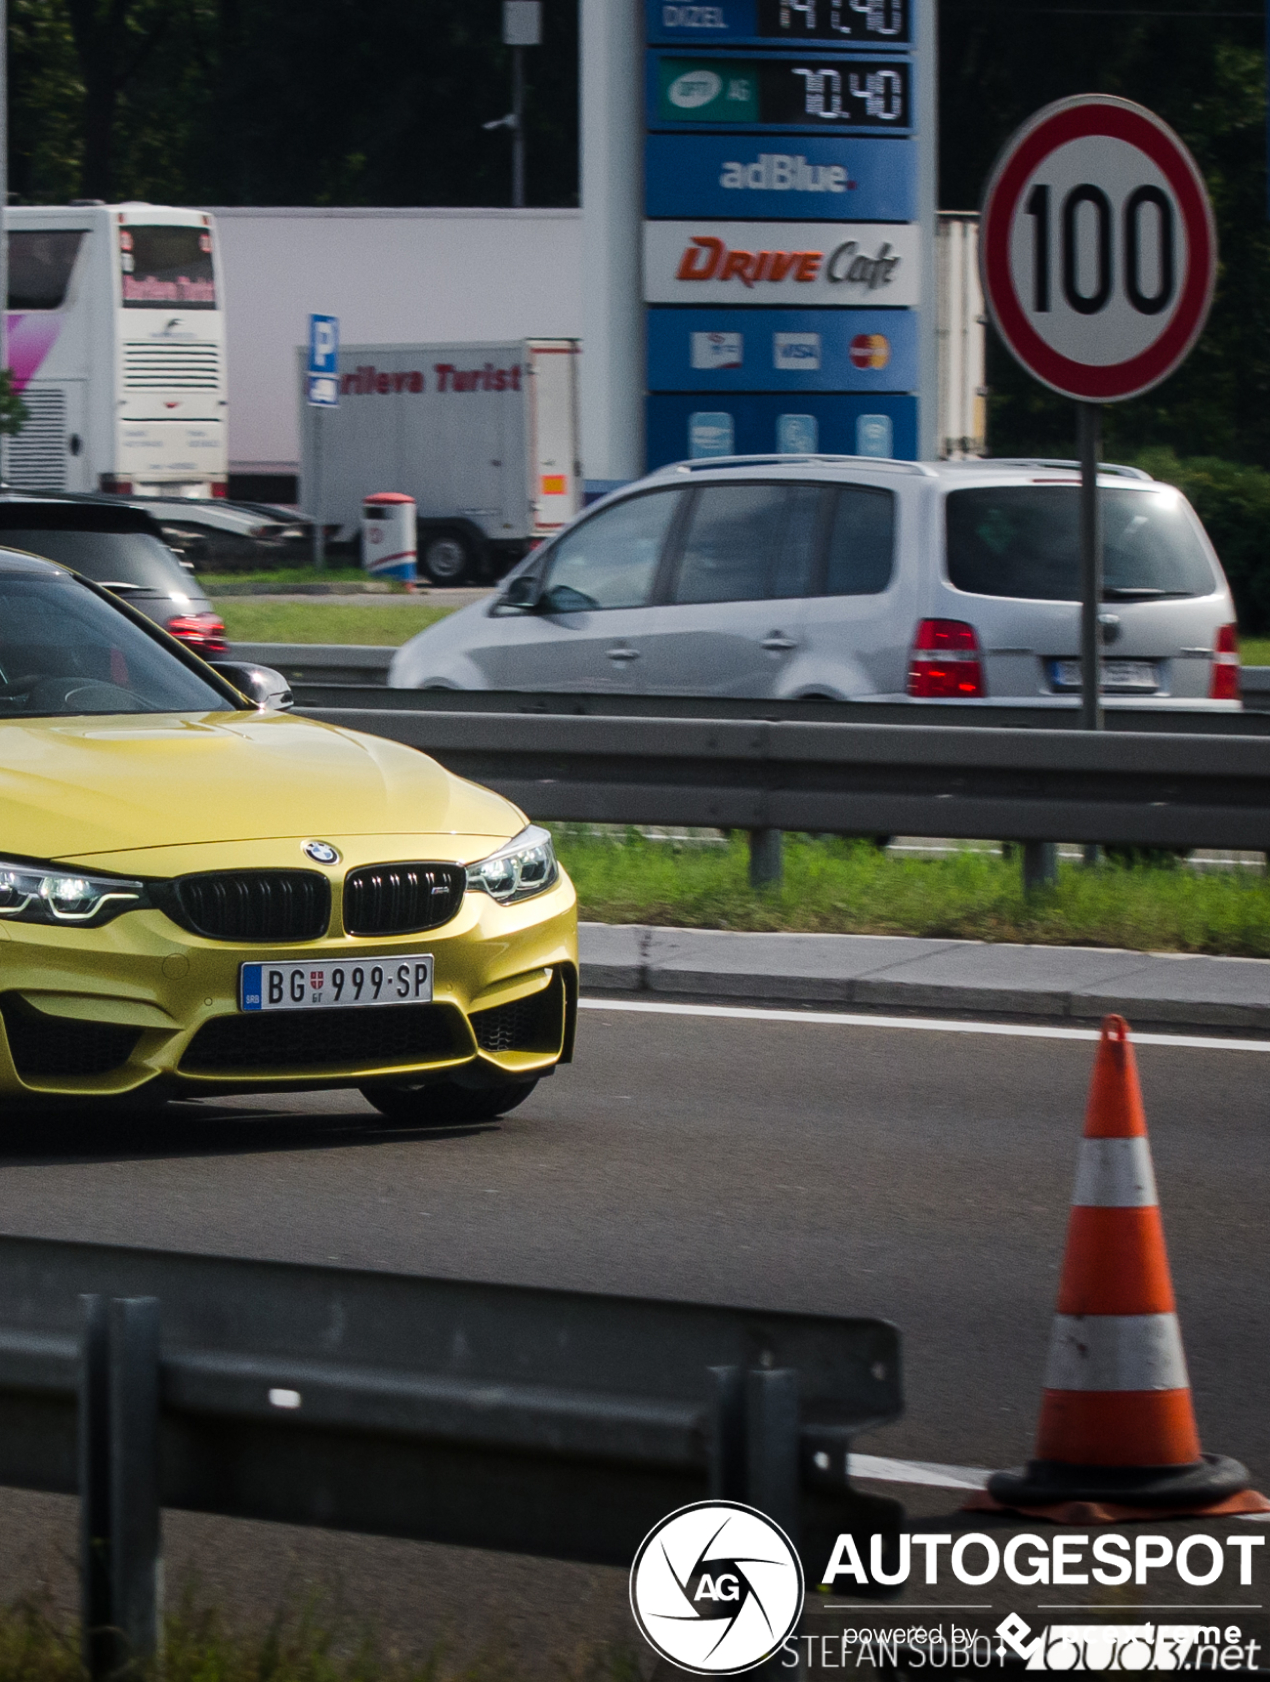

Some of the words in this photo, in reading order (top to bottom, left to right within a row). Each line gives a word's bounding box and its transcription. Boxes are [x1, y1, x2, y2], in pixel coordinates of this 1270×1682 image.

[662, 5, 728, 29] DIZEL
[791, 68, 902, 119] 70.40
[676, 236, 824, 288] DRIVE
[1024, 183, 1178, 316] 100
[314, 321, 334, 367] P
[433, 362, 523, 393] Turist
[268, 968, 306, 1004] BG
